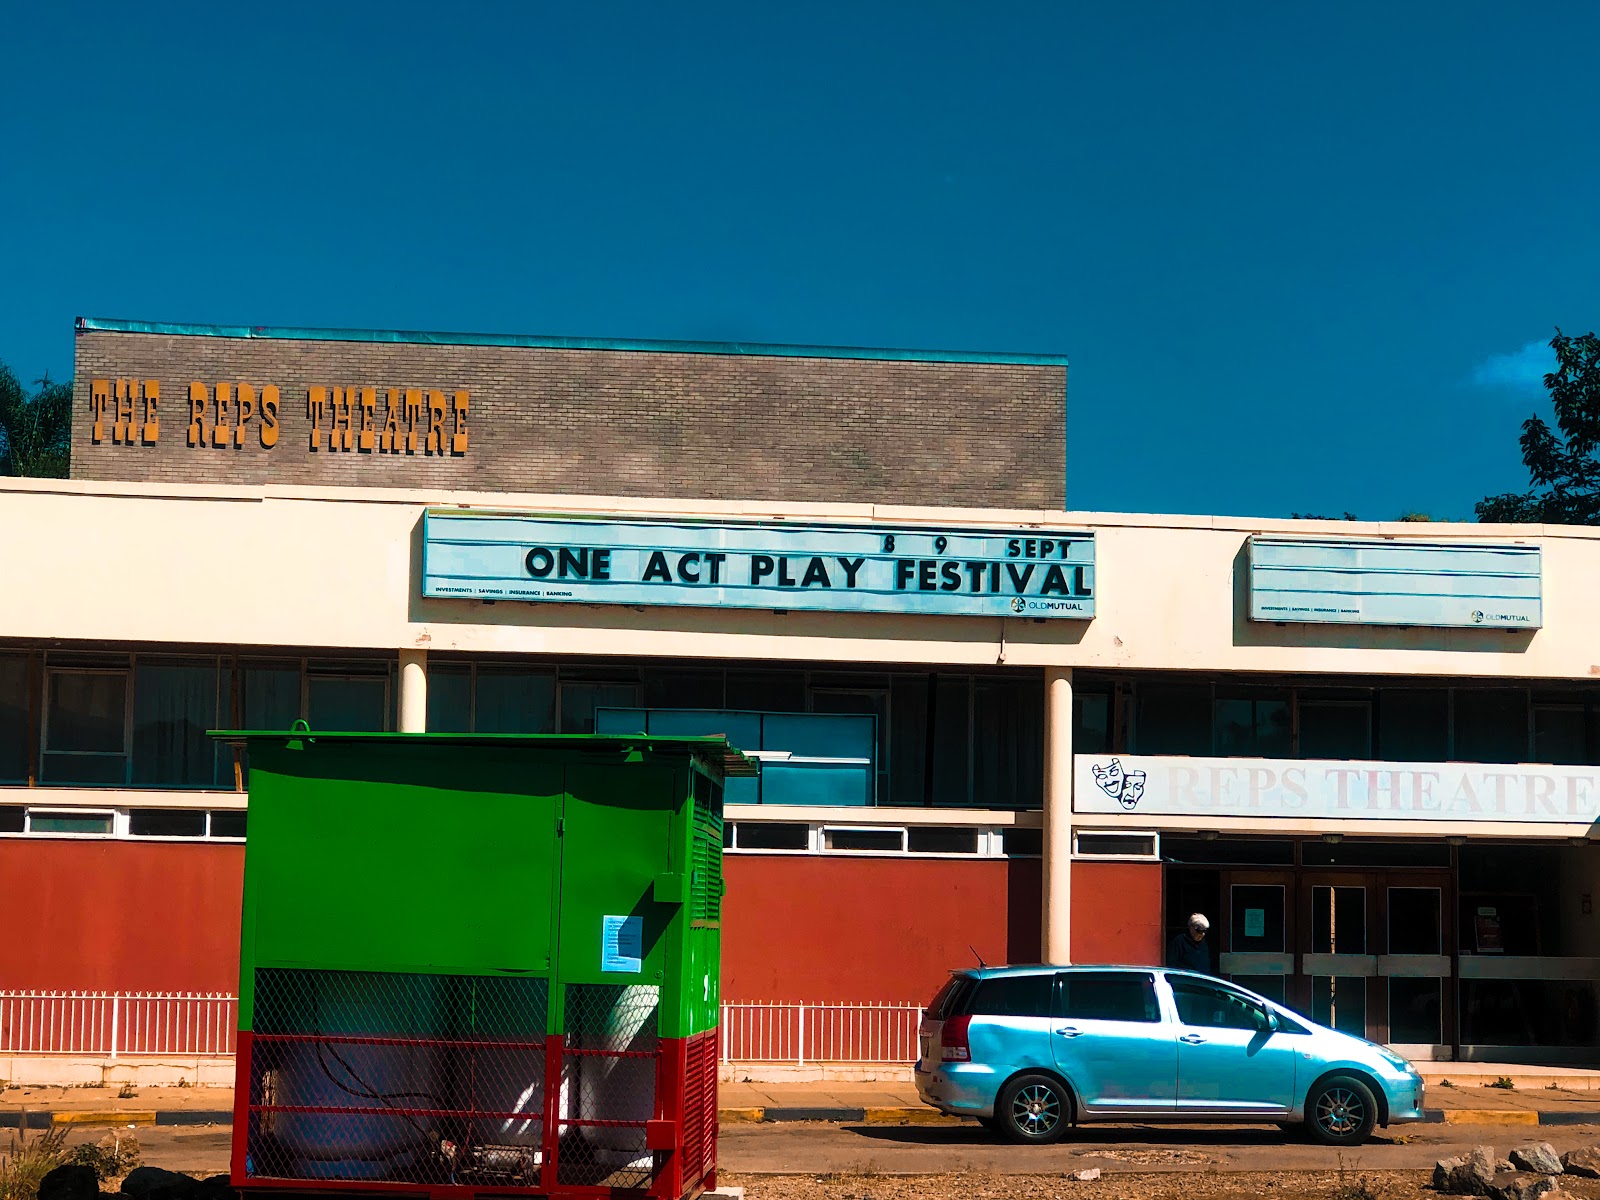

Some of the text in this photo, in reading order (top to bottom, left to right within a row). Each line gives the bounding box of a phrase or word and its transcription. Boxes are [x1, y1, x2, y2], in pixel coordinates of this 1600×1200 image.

[91, 379, 470, 456] THE REPS THEATRE
[525, 547, 1092, 596] ONE ACT PLAY FESTIVAL
[883, 534, 1071, 559] 8 9 SEPT
[1167, 765, 1597, 817] REPS THEATRE
